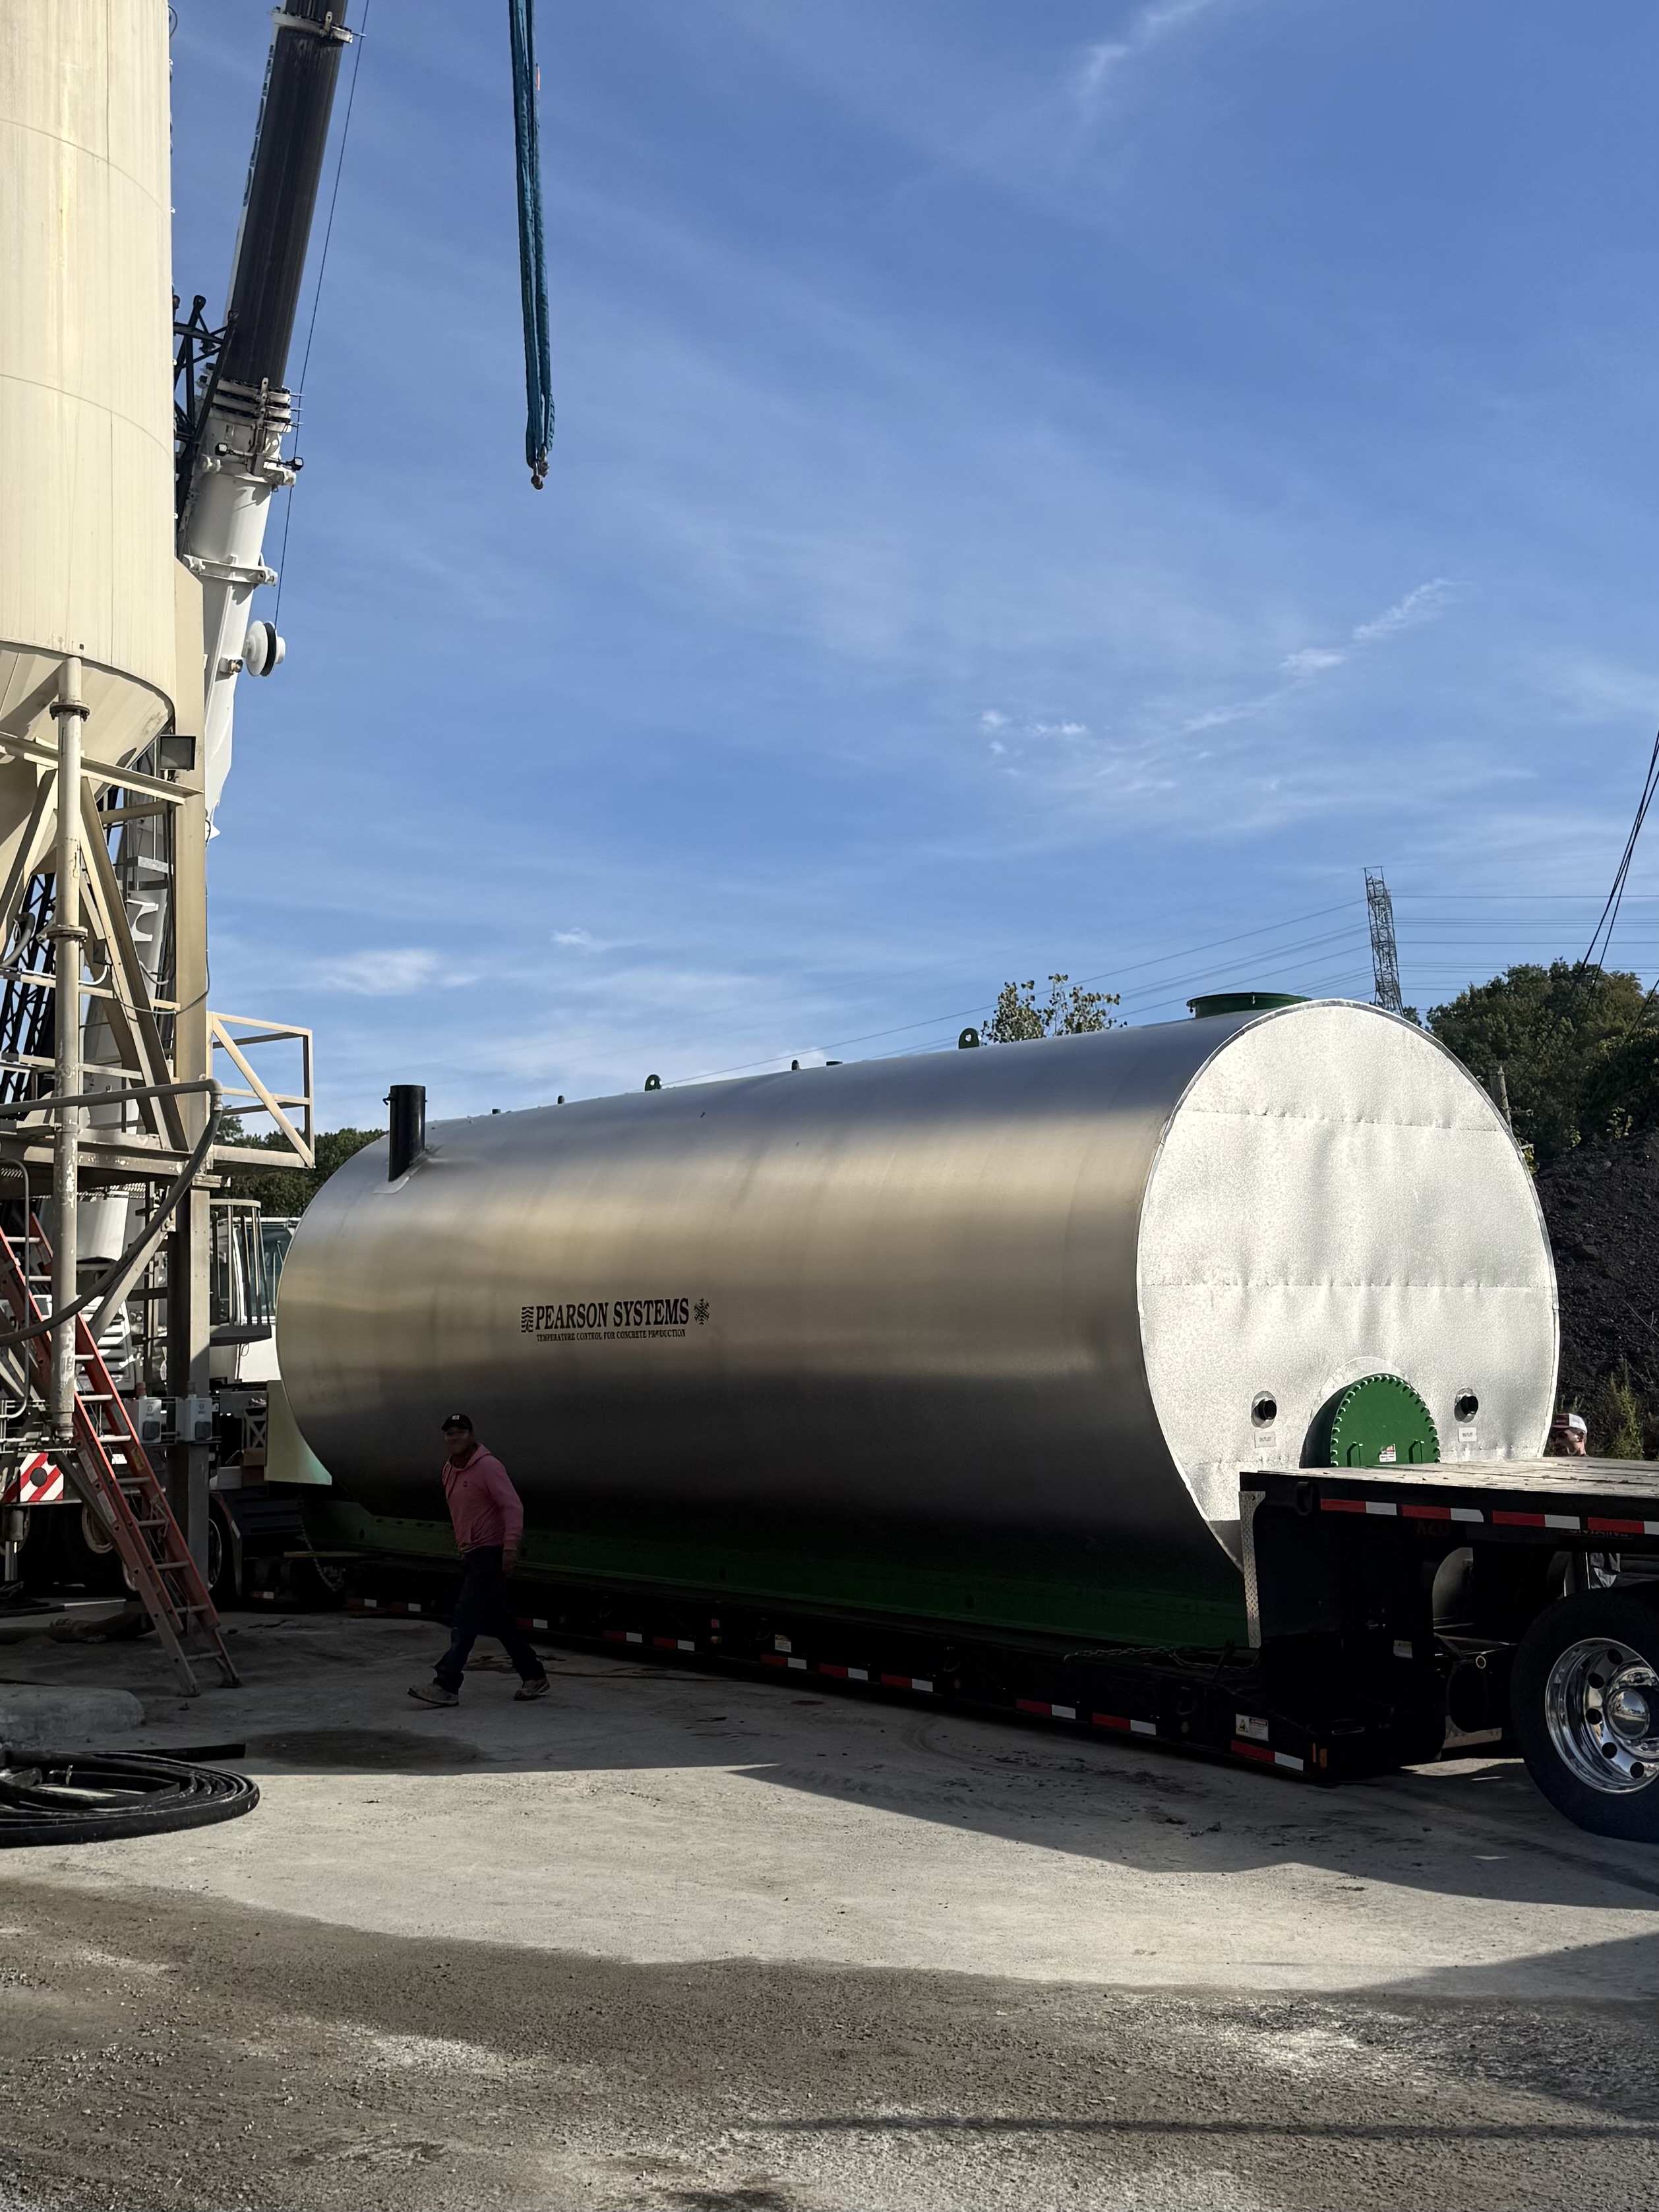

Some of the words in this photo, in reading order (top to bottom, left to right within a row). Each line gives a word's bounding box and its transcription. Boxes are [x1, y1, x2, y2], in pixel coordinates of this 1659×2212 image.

[535, 1302, 609, 1330] PEARSON
[613, 1298, 689, 1327] SYSTEMS
[537, 1333, 575, 1342] TEMPERATURE
[576, 1332, 602, 1340] CONTROL
[603, 1331, 615, 1340] FOR
[617, 1330, 646, 1339] CONCRETE
[648, 1329, 686, 1338] PRODUCTION
